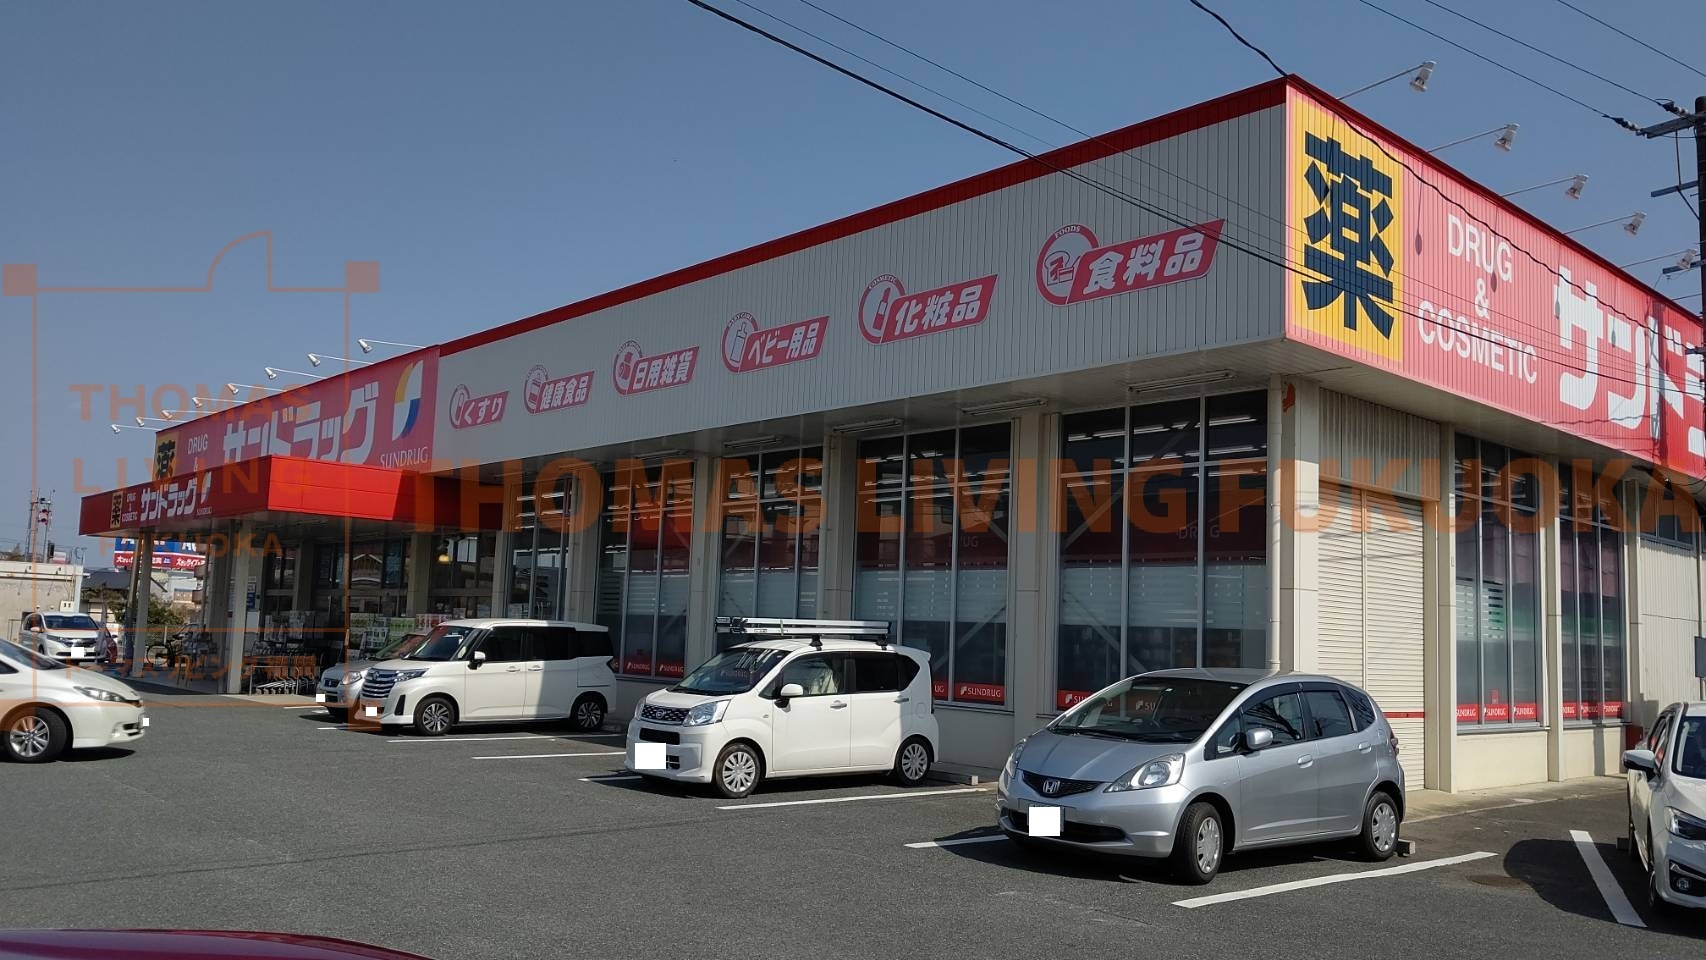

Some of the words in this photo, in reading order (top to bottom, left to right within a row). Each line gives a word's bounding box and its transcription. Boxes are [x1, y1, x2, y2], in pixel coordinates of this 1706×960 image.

[1054, 224, 1081, 239] FOODS
[1301, 130, 1395, 341] 薬
[1447, 213, 1513, 284] DRUG
[1082, 230, 1205, 295] 食料品
[894, 284, 983, 336] 化粧品
[1474, 277, 1490, 320] &
[747, 321, 820, 366] ベビー用品
[1417, 299, 1538, 385] COSMETIC
[632, 350, 694, 390] 日用雑貨
[462, 396, 503, 424] くすり
[539, 374, 590, 411] 健康食品
[187, 433, 209, 455] DRUG
[222, 380, 380, 466] サンドラッグ
[379, 446, 429, 469] SUNDRUG
[140, 477, 198, 522] サンドラッグ
[967, 687, 1001, 698] SUNDRUG
